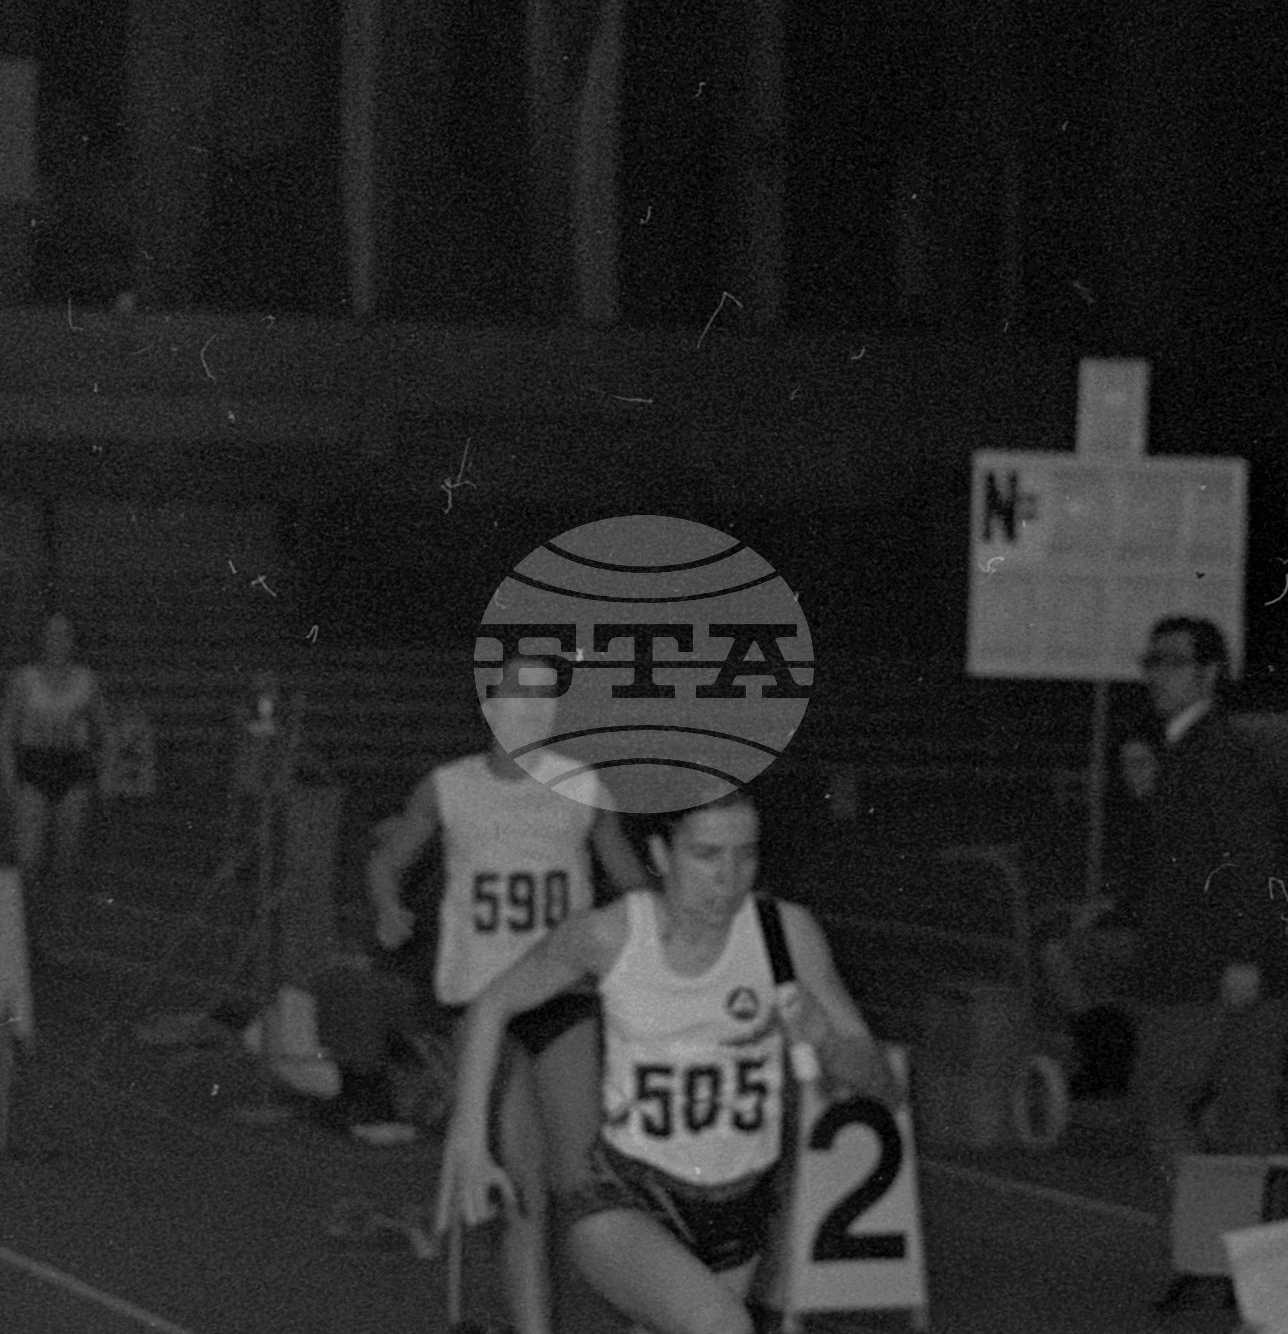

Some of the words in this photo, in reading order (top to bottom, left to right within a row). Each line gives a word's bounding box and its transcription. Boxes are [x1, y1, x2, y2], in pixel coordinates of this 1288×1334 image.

[473, 870, 569, 933] 590
[636, 1060, 767, 1137] 505
[810, 1095, 905, 1262] 2
